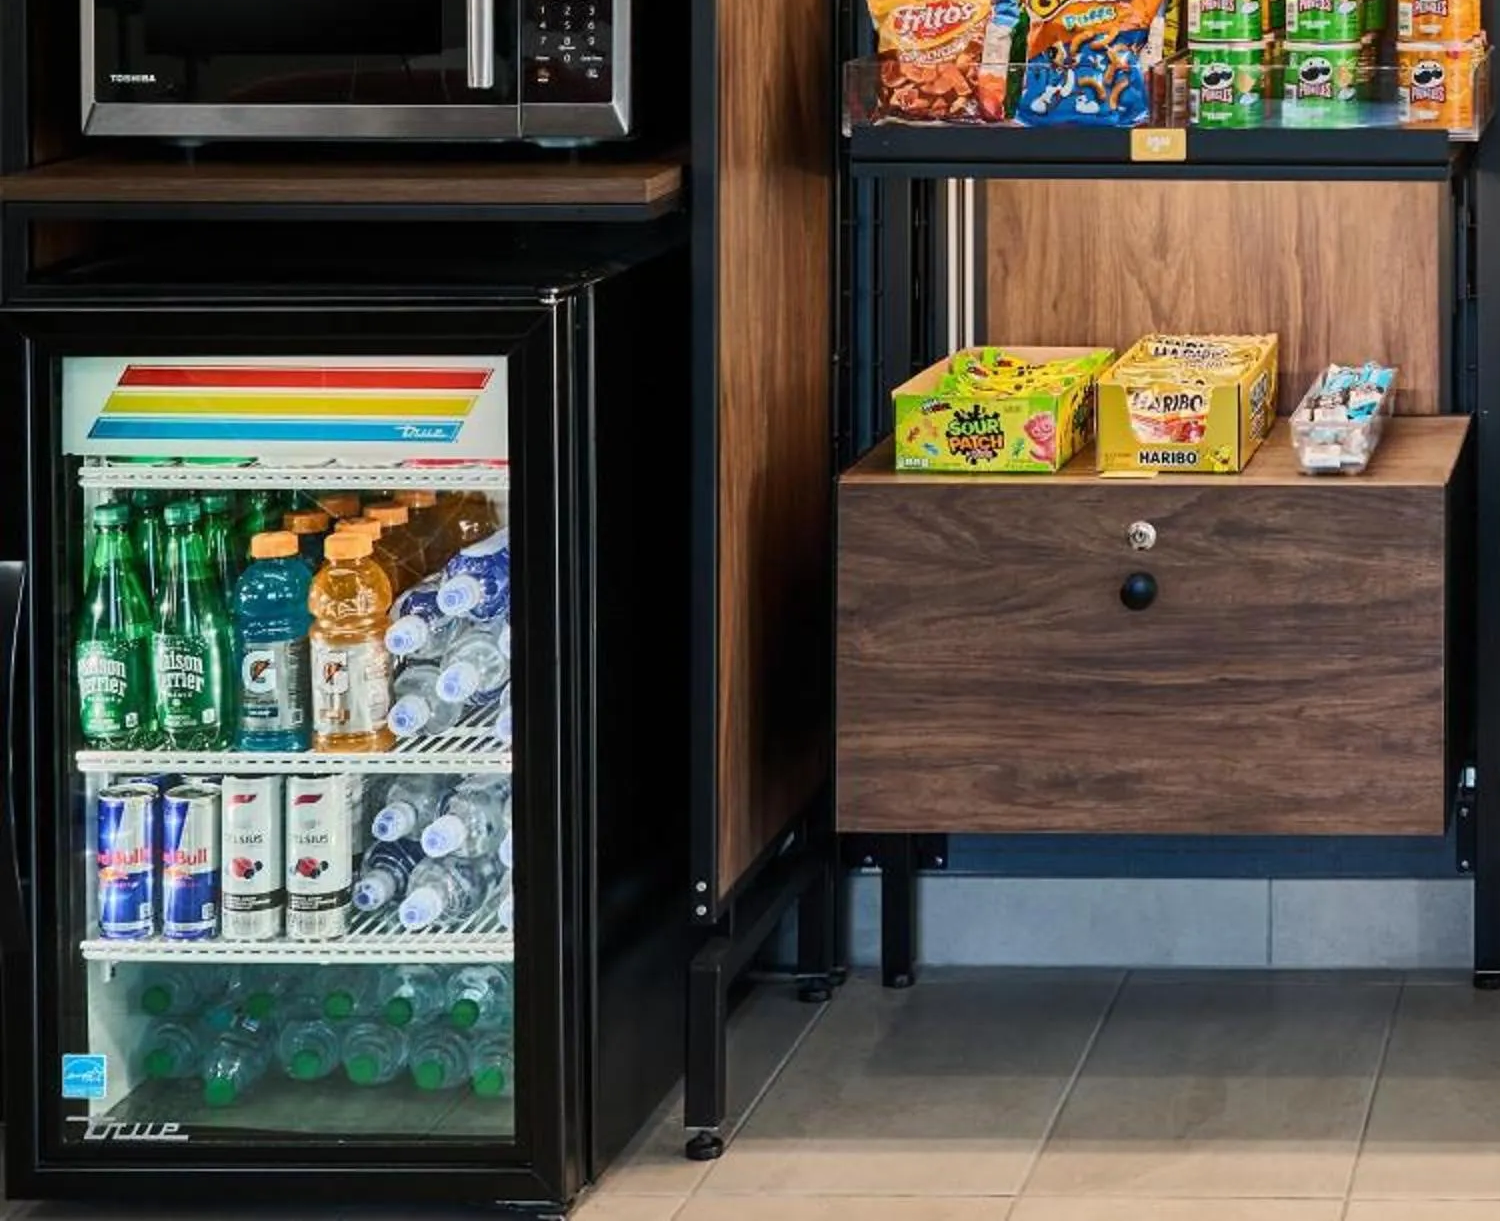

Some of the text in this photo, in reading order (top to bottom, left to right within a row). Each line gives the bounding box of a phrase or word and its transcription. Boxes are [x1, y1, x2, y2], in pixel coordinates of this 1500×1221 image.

[898, 1, 976, 31] Fritos
[1133, 393, 1203, 413] HARIBO
[950, 419, 999, 436] SOUR
[950, 435, 1004, 450] PATCH
[1139, 451, 1197, 464] HARIBO
[176, 848, 207, 865] Bull
